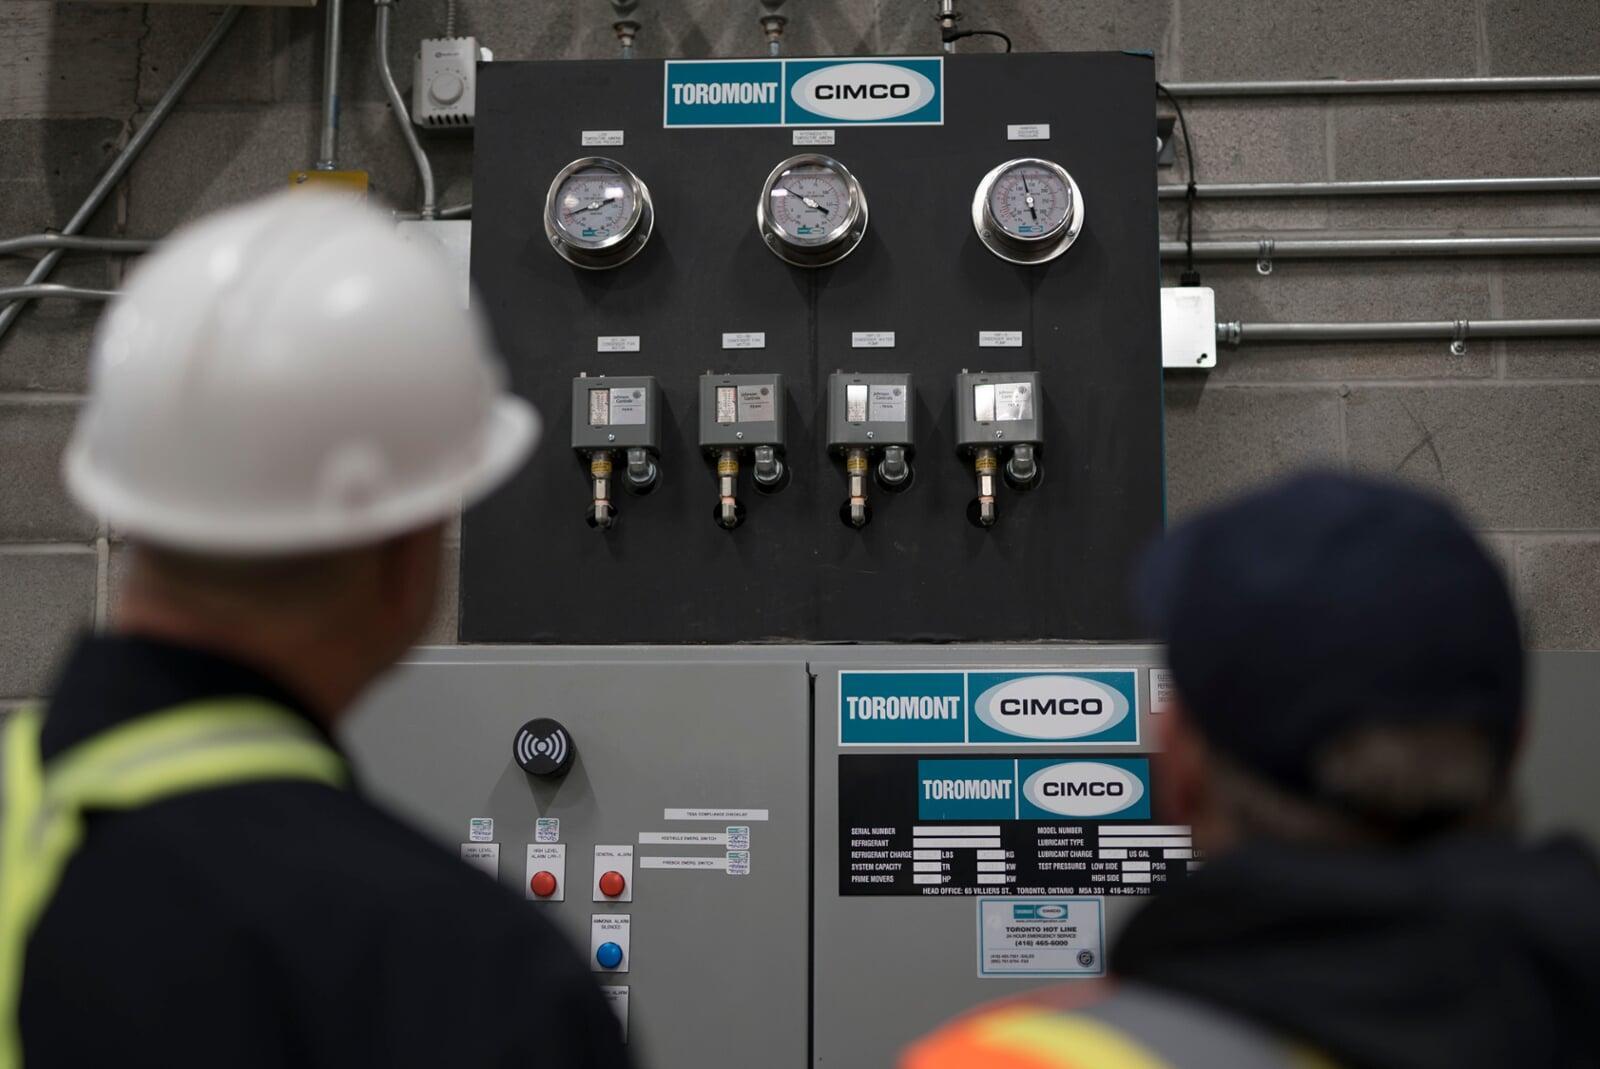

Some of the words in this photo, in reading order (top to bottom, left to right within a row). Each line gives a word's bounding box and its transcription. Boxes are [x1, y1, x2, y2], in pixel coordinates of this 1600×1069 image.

[672, 82, 778, 105] TOROMONT
[814, 83, 911, 100] CIMCO
[846, 696, 960, 720] TOROMONT
[1000, 698, 1103, 716] CIMCO
[923, 779, 1012, 800] TOROMONT
[1043, 781, 1124, 797] CIMCO
[851, 827, 870, 835] SERIAL
[872, 827, 896, 835] NUMBER
[851, 863, 874, 871] SYSTEM
[875, 863, 902, 871] CAPACITY
[942, 863, 951, 871] TR
[1006, 863, 1016, 871] KW
[851, 875, 870, 883] PRIME
[870, 875, 894, 883] MOVERS
[942, 875, 951, 883] HP
[1006, 875, 1017, 883] KW
[1091, 874, 1105, 882] HIGH
[1106, 874, 1120, 882] SIDE
[923, 887, 939, 895] HEAD
[941, 887, 963, 895] OFFICE:
[974, 887, 1000, 895] VILLIERS
[1017, 887, 1047, 895] TORONTO,
[1048, 887, 1074, 895] ONTARIO
